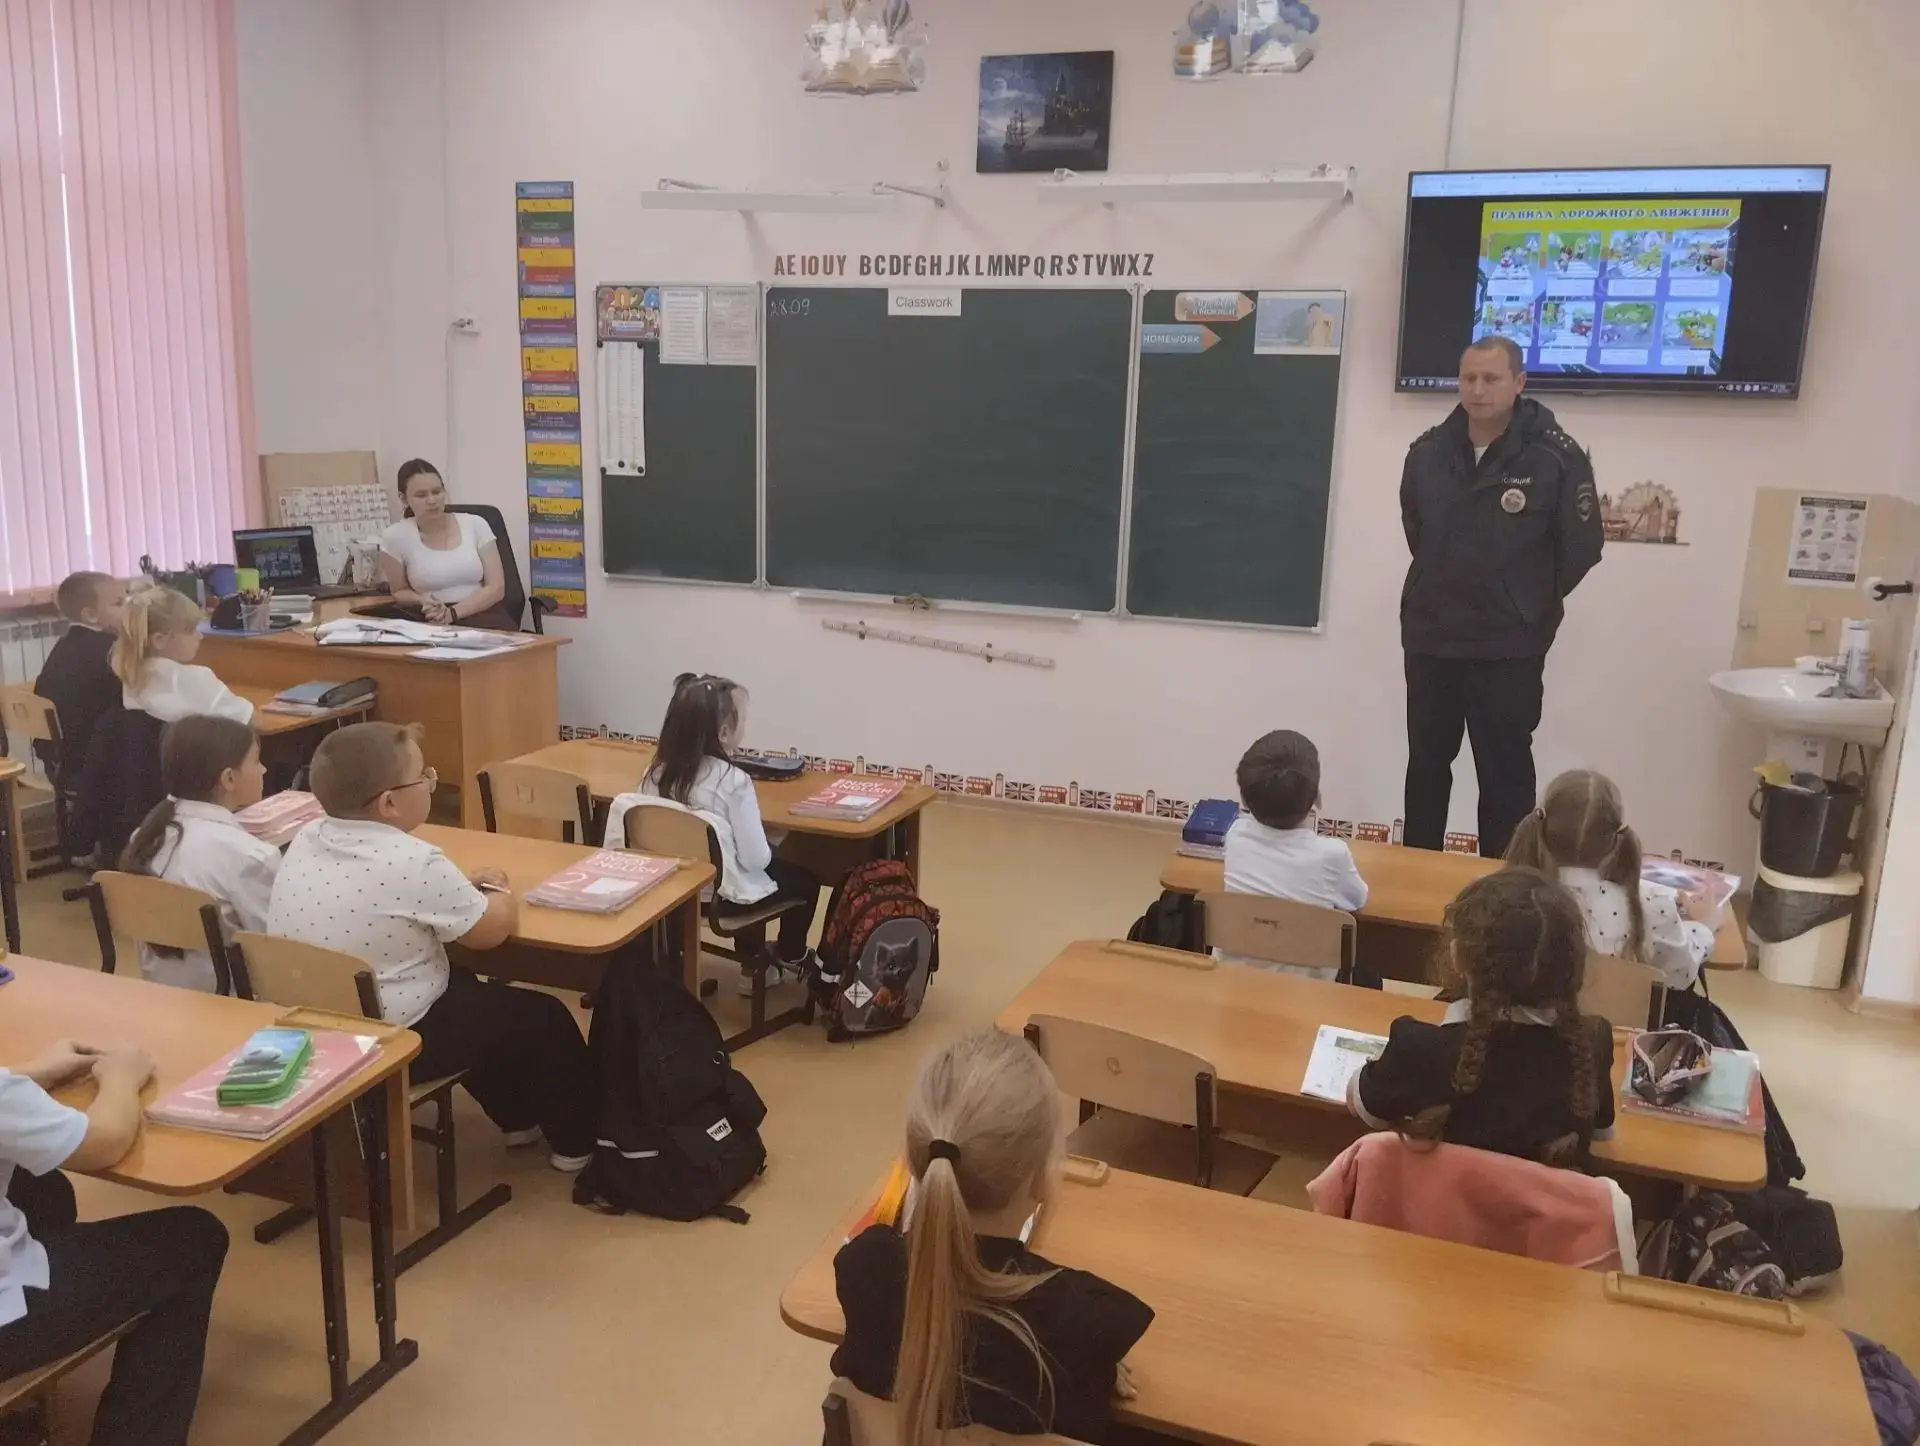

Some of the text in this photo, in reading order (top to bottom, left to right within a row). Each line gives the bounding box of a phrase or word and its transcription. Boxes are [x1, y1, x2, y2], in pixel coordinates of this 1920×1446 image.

[1491, 207, 1731, 220] ПРАВИЛА ДОРОЖНОГО ДВИЖЕНИЯ
[896, 296, 952, 308] Classwork
[1143, 334, 1200, 344] HOMEWORK
[548, 872, 588, 890] 2
